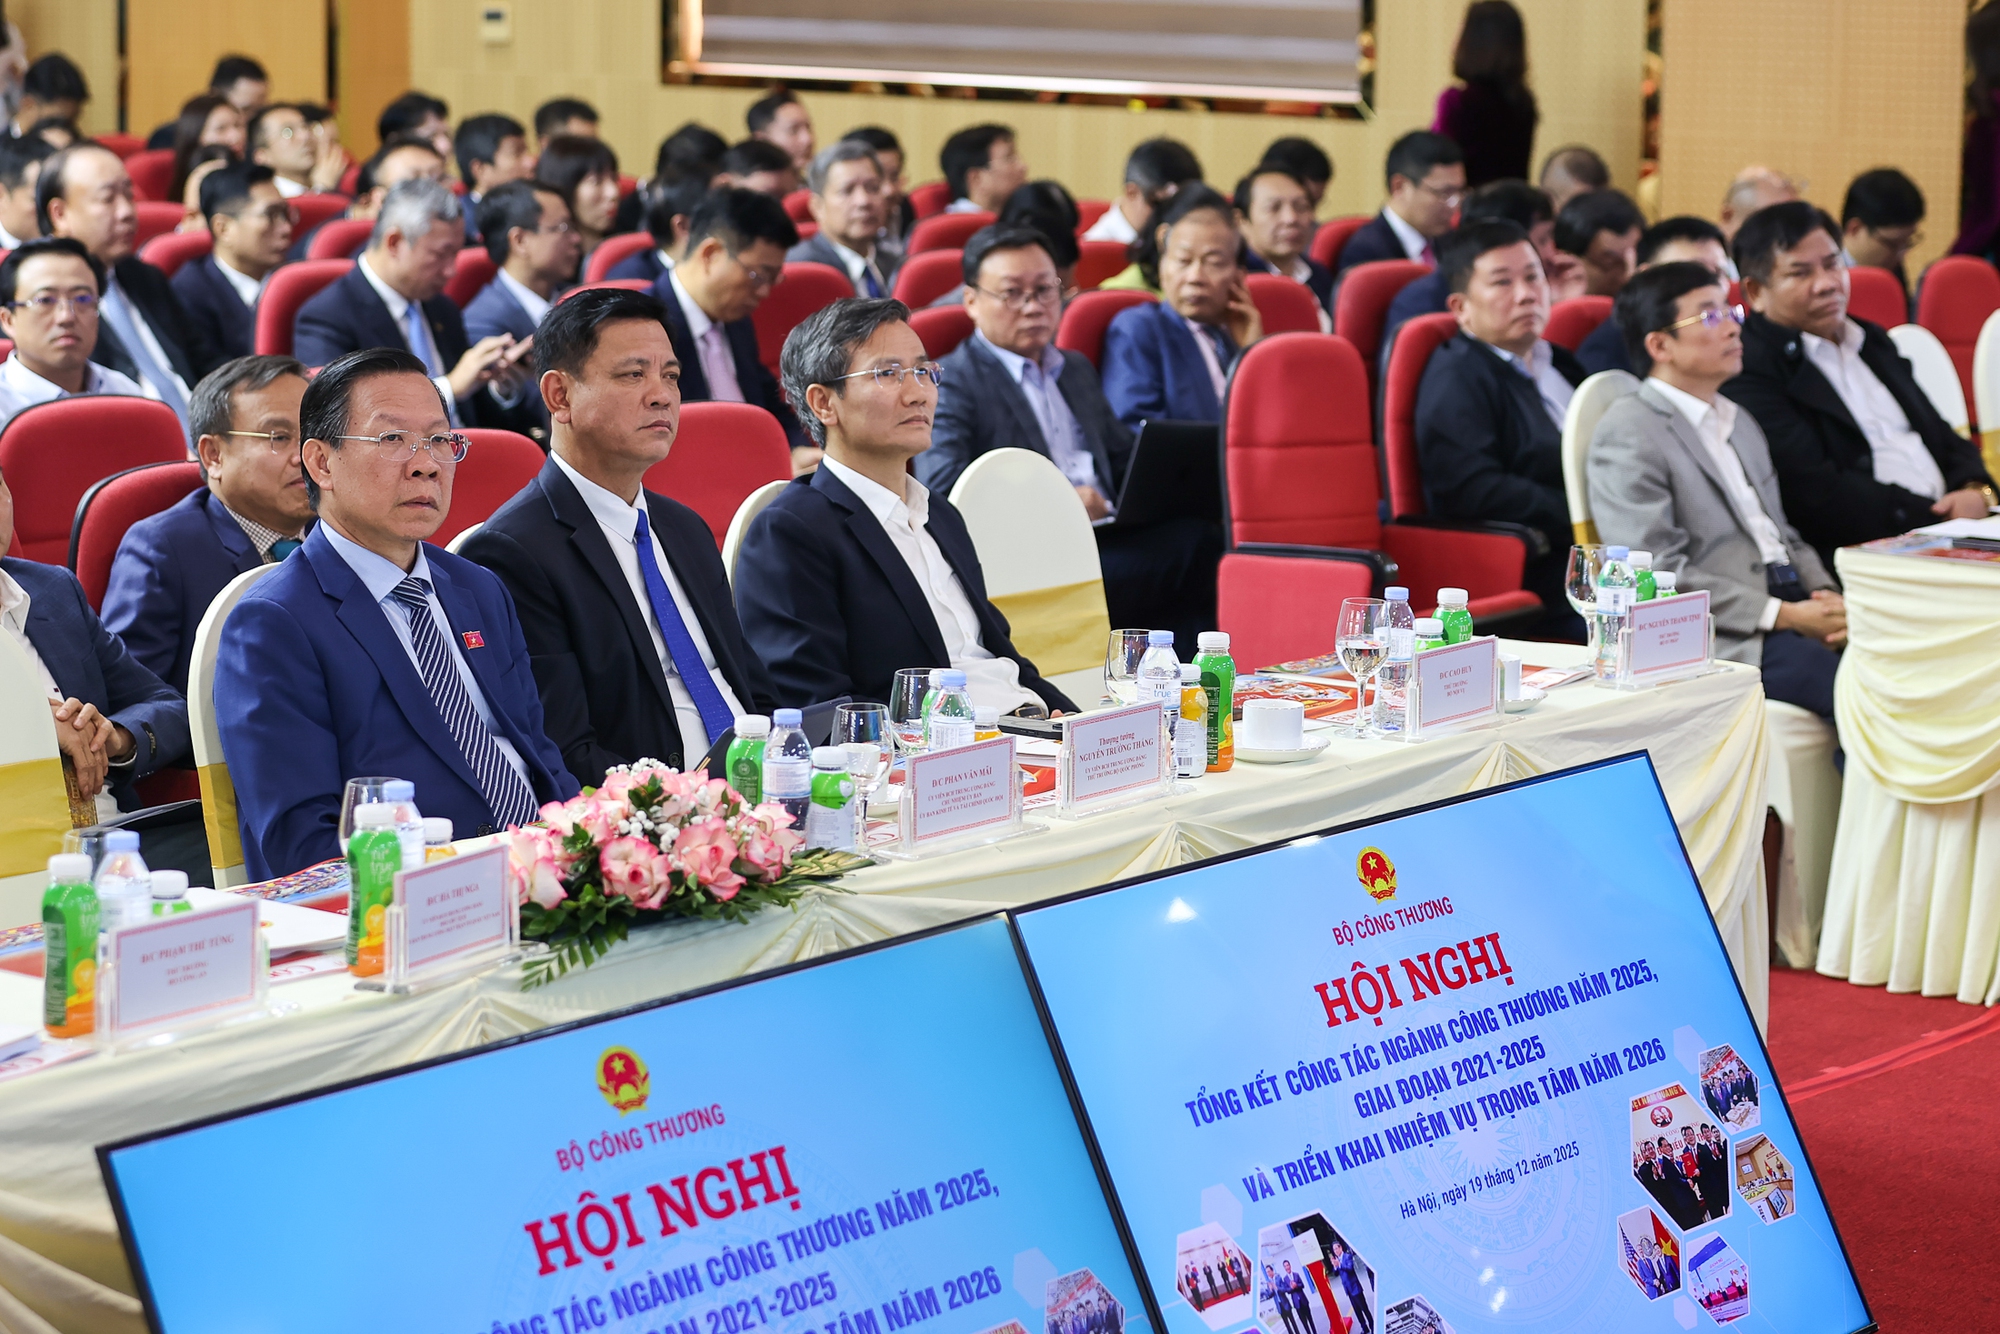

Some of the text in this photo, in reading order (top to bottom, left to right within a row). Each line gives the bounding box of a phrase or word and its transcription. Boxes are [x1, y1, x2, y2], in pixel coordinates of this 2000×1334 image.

[1154, 690, 1171, 698] true
[944, 773, 962, 785] PHAN
[964, 769, 978, 780] VĂN
[1079, 749, 1104, 762] NGUYỄN
[1106, 743, 1131, 756] TRƯỜNG
[1332, 896, 1454, 946] BỘ CÔNG THƯƠNG
[1313, 932, 1514, 1028] HỘI NGHỊ
[1184, 958, 1659, 1128] TỔNG KẾT CÔNG TÁC NGÀNH CÔNG THƯƠNG NĂM 2025,
[1353, 1034, 1546, 1119] GIAI ĐOẠN 2021-2025
[556, 1103, 726, 1172] BỘ CÔNG THƯƠNG
[1242, 1037, 1667, 1203] VÀ TRIỂN KHAI NHIỆM VỤ TRỌNG TÂM NĂM 2026
[524, 1145, 802, 1277] HỘI NGHỊ
[1400, 1141, 1580, 1219] Hà Nội, ngày 19 tháng 12 năm 2025
[552, 1294, 607, 1334] TÁC
[610, 1263, 704, 1320] NGÀNH
[705, 1245, 777, 1287] CÔNG
[777, 1206, 875, 1263] THƯƠNG
[875, 1187, 934, 1231] NĂM
[934, 1167, 1000, 1211] 2025,
[705, 1270, 838, 1334] 2021-2025
[881, 1286, 942, 1333] NĂM
[943, 1265, 1002, 1310] 2026
